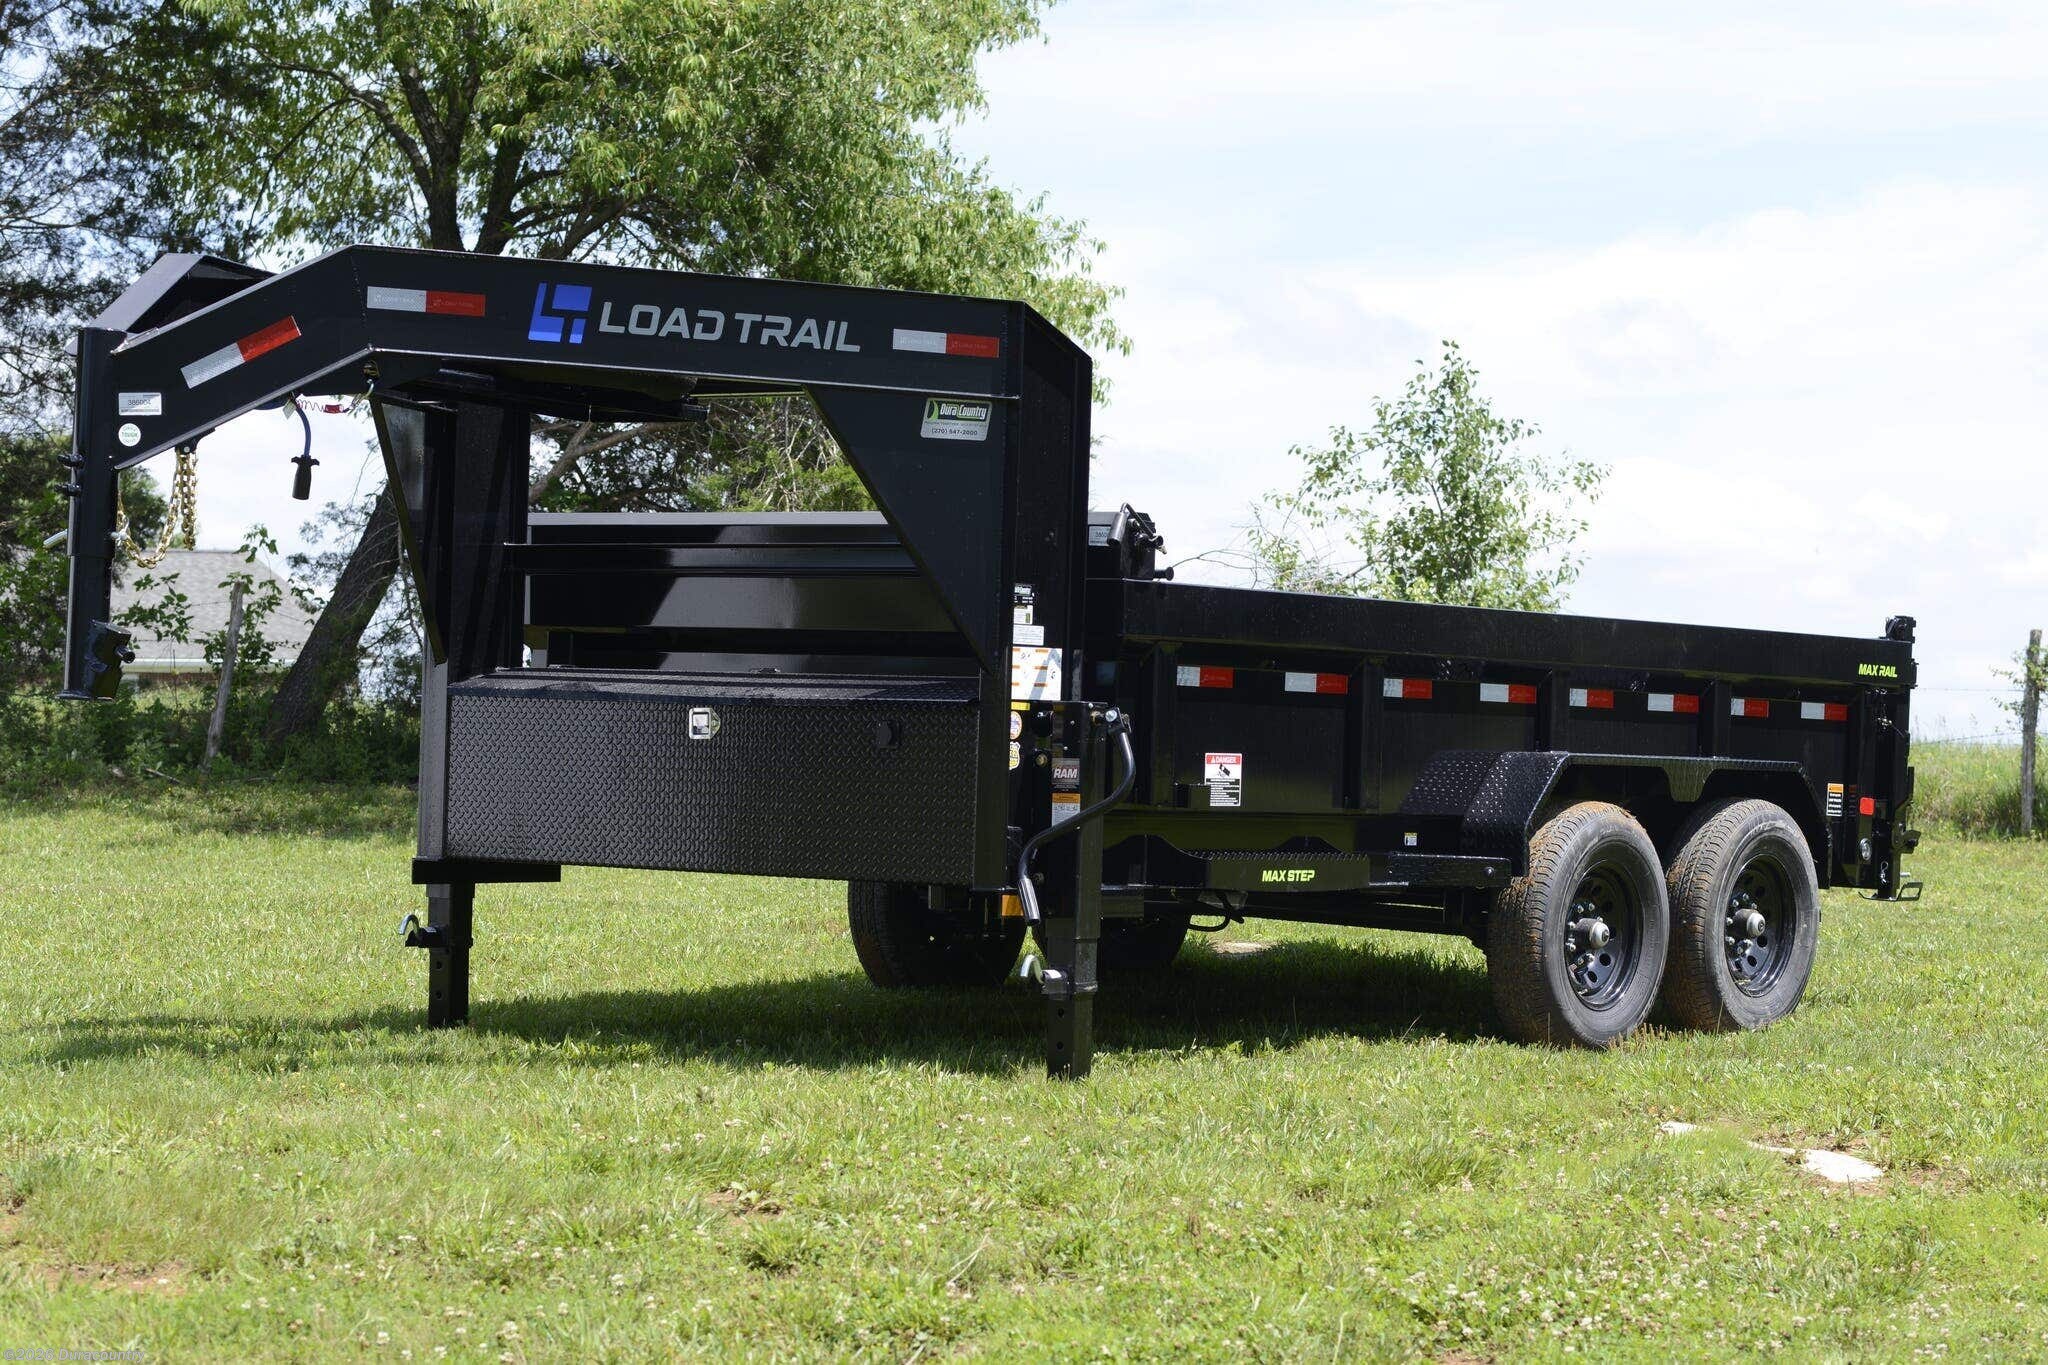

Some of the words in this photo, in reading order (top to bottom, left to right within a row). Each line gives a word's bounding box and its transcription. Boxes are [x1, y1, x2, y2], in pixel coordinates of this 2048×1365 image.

[599, 301, 725, 341] LOAD
[734, 312, 861, 352] TRAIL
[940, 403, 958, 416] Dura
[958, 404, 987, 420] Country
[1858, 663, 1879, 677] MAX
[1879, 665, 1898, 678] RAIL
[1053, 767, 1079, 779] RAM
[1262, 870, 1287, 882] MAX
[1287, 870, 1315, 882] STEP
